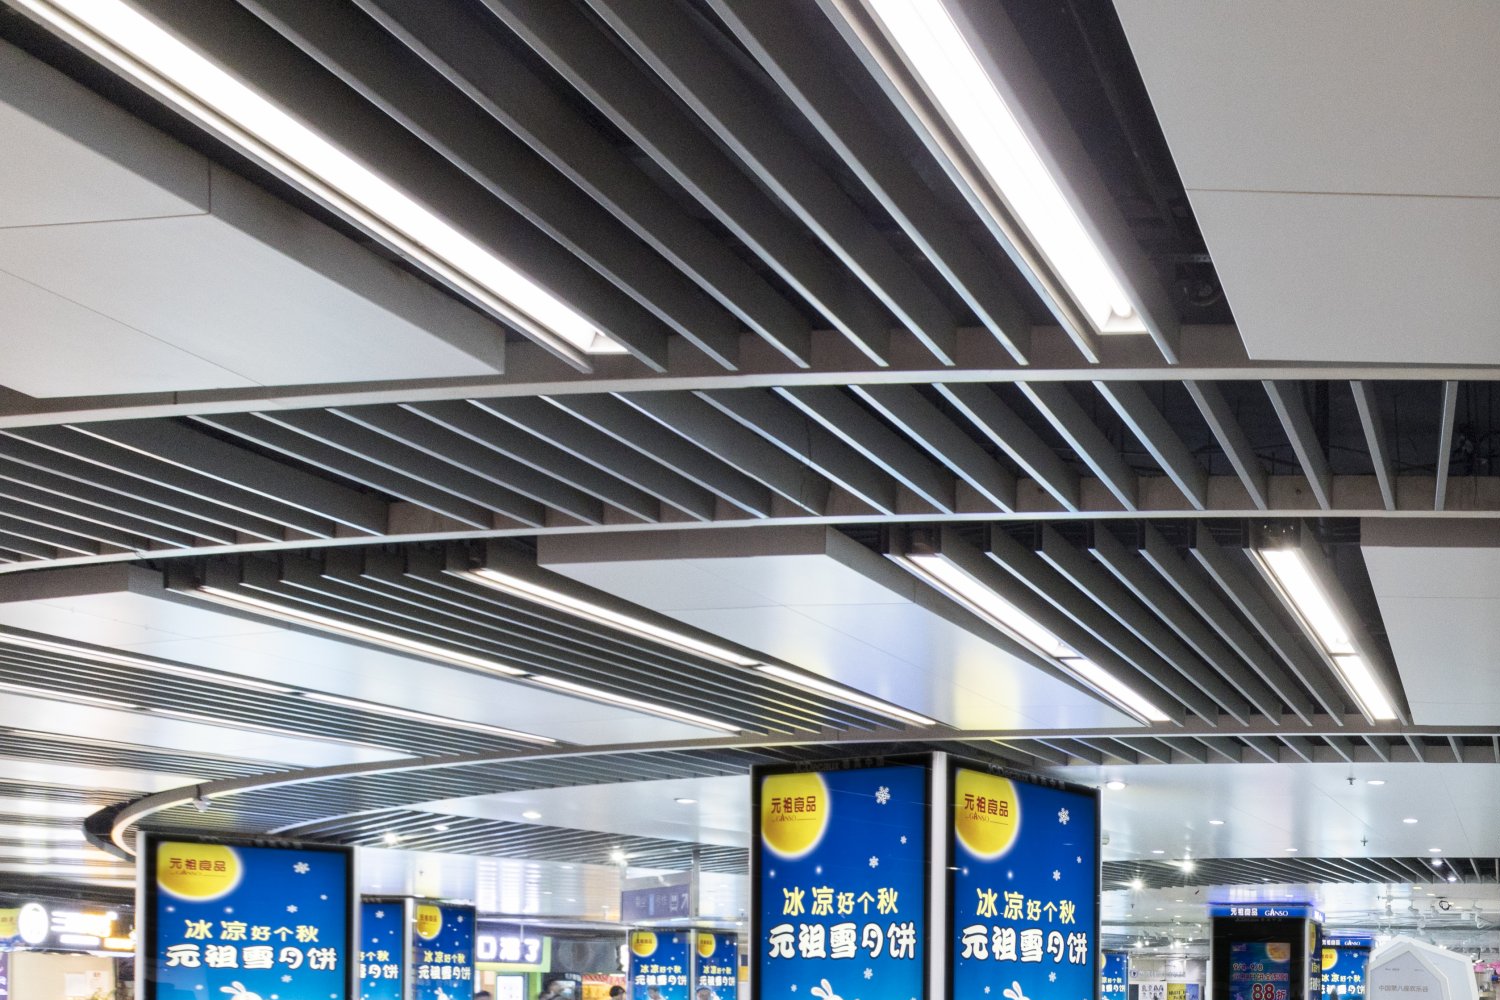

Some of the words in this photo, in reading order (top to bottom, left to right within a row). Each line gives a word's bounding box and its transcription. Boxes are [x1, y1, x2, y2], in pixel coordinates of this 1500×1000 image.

[783, 886, 899, 916] 冰凉好个秋
[976, 887, 1076, 925] 冰凉好个秋
[1264, 907, 1289, 916] GANSO
[184, 918, 320, 943] 冰凉好个秋
[768, 920, 918, 960] 元祖雪月饼
[961, 924, 1088, 965] 元祖雪月饼
[165, 943, 338, 971] 元祖雪月饼
[423, 950, 466, 964] 冰凉好个秋
[418, 964, 472, 980] 元祖雪月饼
